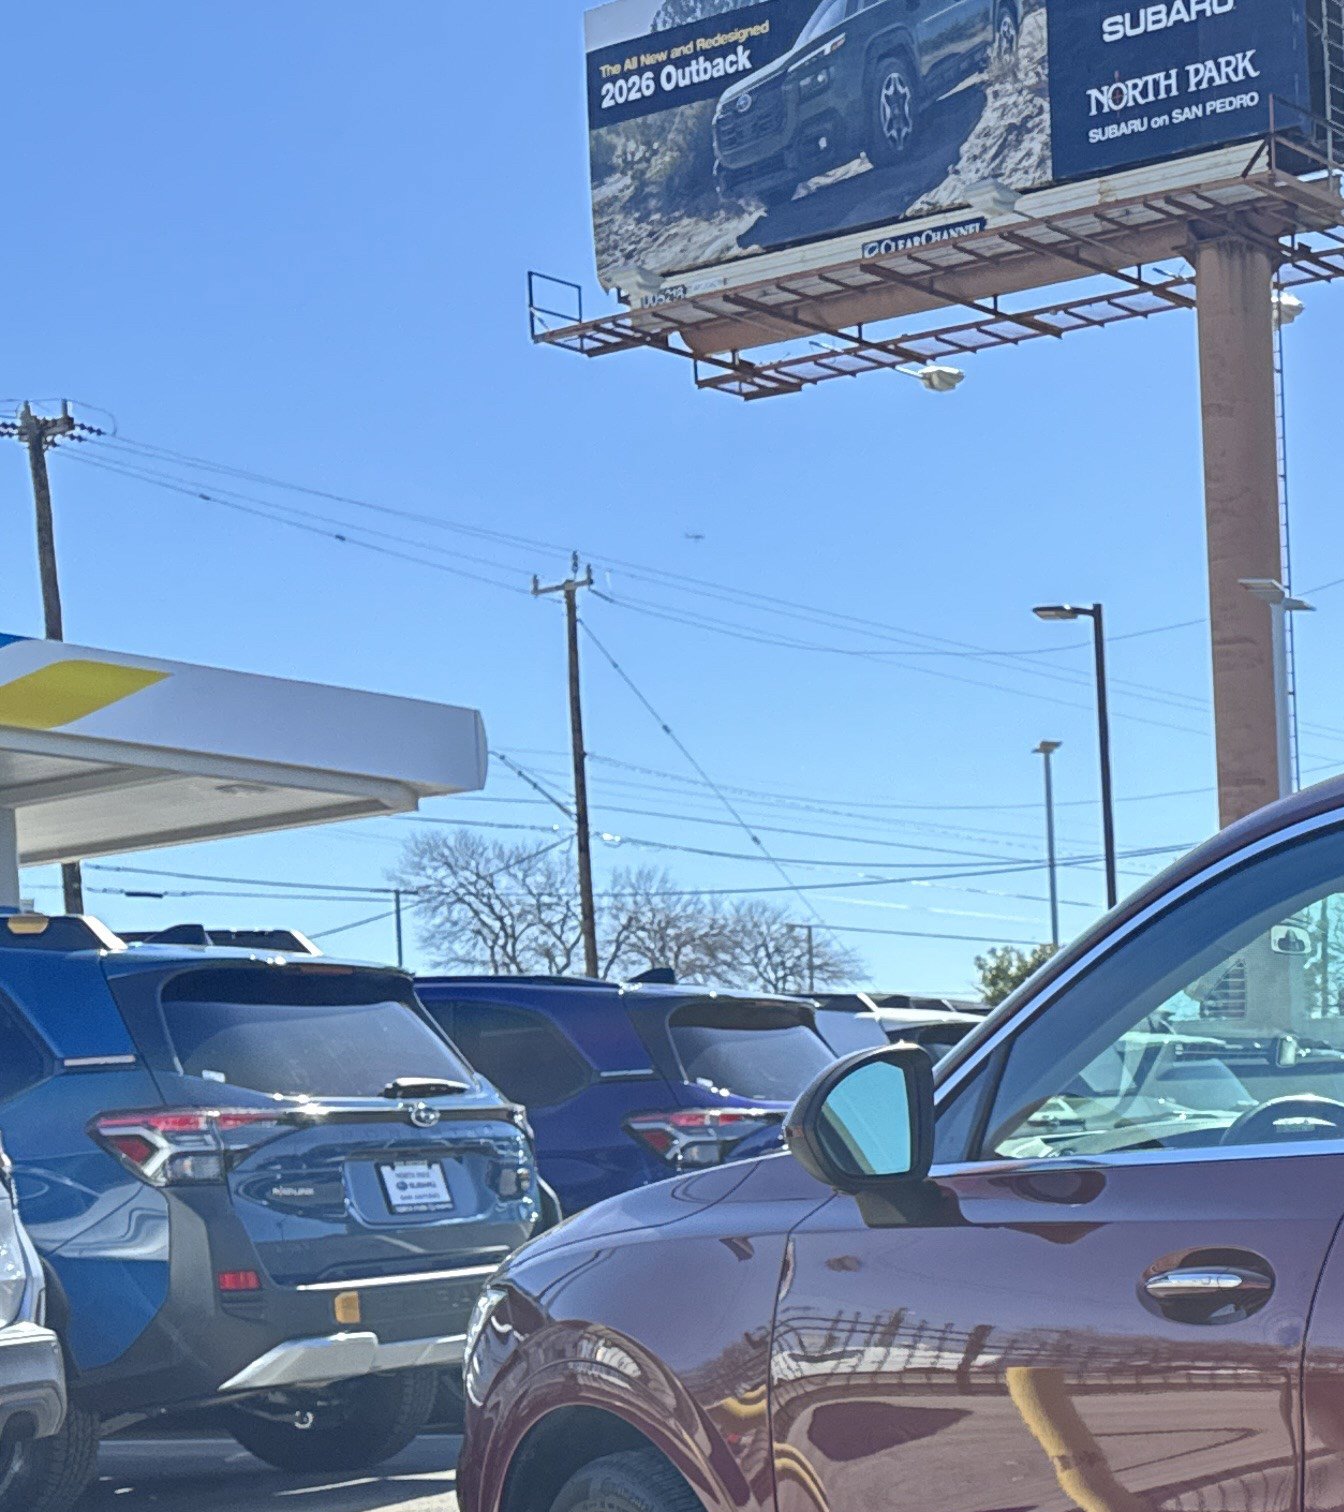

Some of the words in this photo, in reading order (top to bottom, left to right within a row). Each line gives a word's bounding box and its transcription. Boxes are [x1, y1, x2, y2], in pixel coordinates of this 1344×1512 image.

[599, 63, 622, 78] The
[623, 55, 638, 72] All
[640, 50, 669, 66] New
[670, 40, 694, 59] and
[696, 19, 770, 51] Redesigned
[1102, 0, 1235, 43] SUBARU
[601, 71, 656, 109] 2026
[660, 44, 753, 92] Outback
[1085, 68, 1180, 117] NORTH
[1185, 49, 1261, 93] PARK
[1088, 116, 1149, 144] SUBARU
[1150, 114, 1170, 129] on
[1171, 103, 1203, 124] SAN
[1205, 91, 1260, 116] PEDRO
